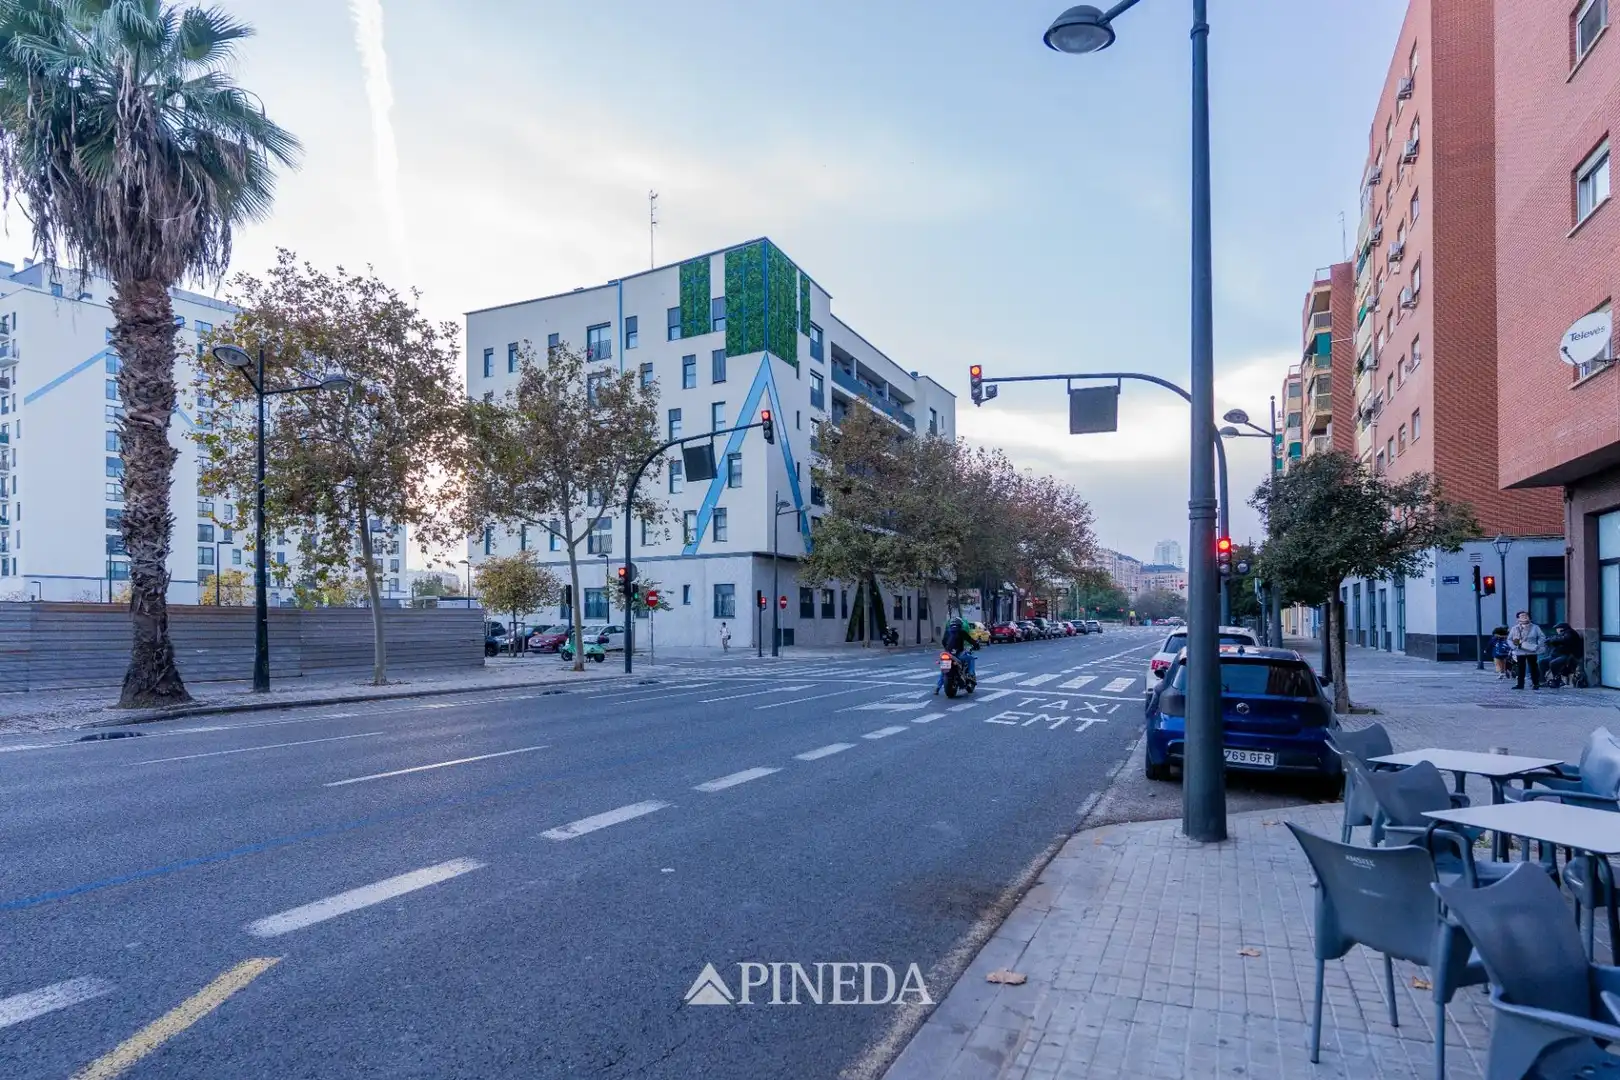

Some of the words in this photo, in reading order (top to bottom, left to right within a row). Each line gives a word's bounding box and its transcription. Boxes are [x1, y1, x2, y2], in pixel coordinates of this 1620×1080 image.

[1017, 698, 1121, 714] TAXI
[984, 710, 1108, 732] EMT
[1224, 750, 1246, 761] 769
[1250, 752, 1272, 764] GFR
